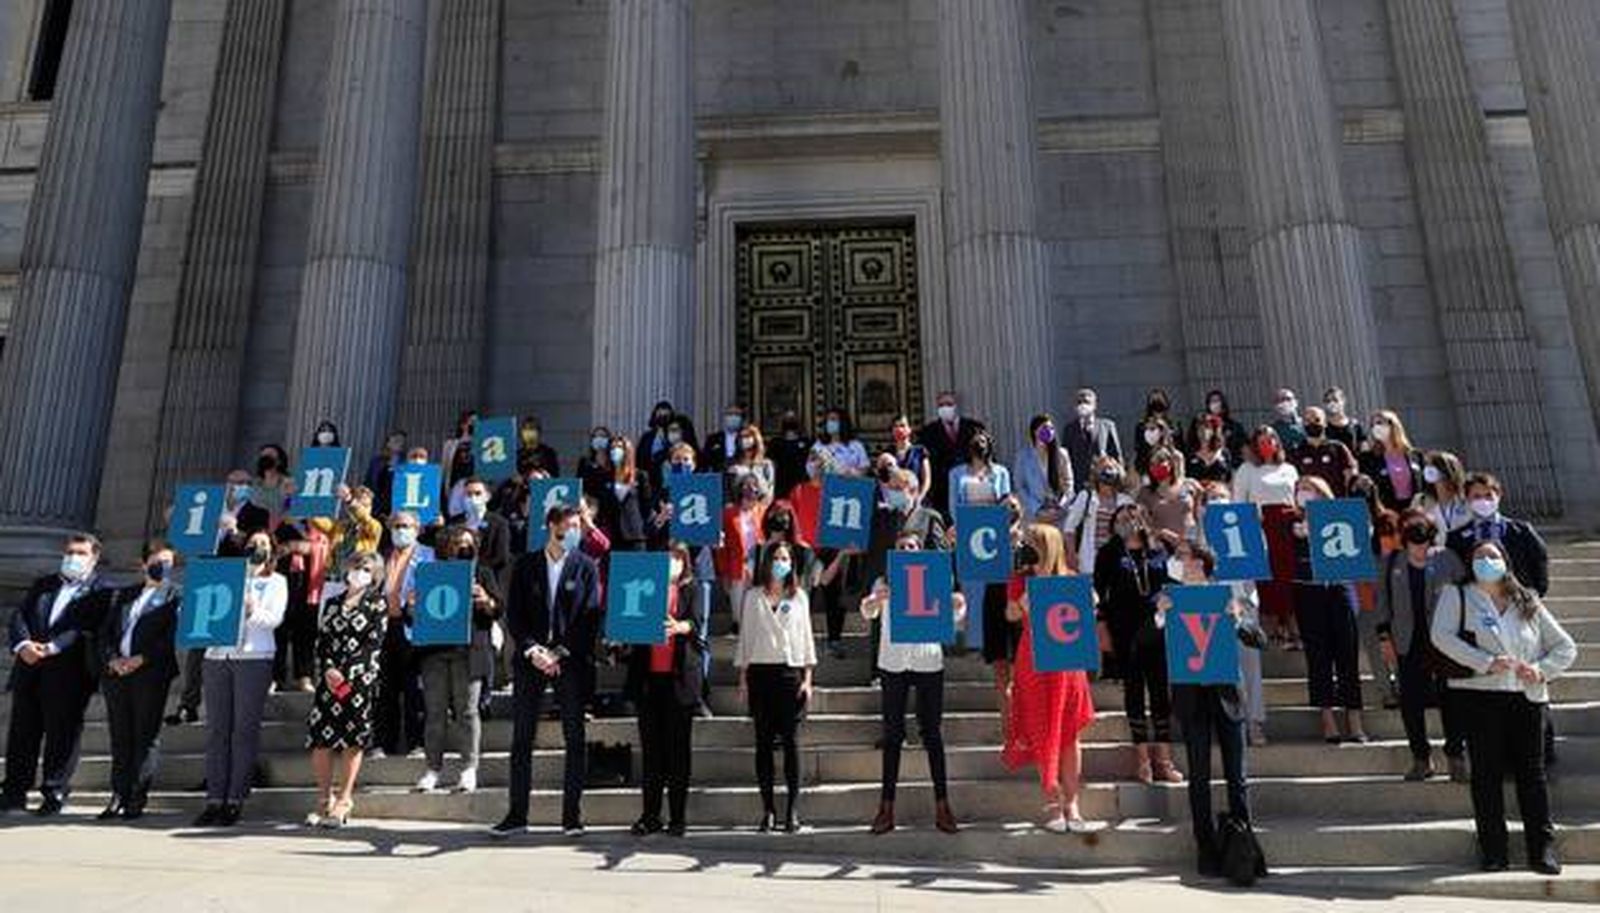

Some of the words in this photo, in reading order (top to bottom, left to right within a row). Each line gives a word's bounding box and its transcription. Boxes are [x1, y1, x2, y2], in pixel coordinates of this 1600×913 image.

[482, 436, 506, 462] a
[303, 468, 333, 497] n
[185, 491, 208, 535] i
[680, 494, 710, 524] a
[828, 497, 862, 531] n
[970, 528, 997, 559] c
[1222, 511, 1246, 557] i
[1321, 523, 1360, 557] a
[187, 584, 232, 638] p
[427, 585, 459, 620] o
[622, 579, 655, 616] r
[1047, 603, 1080, 643] e
[1180, 613, 1221, 671] y
